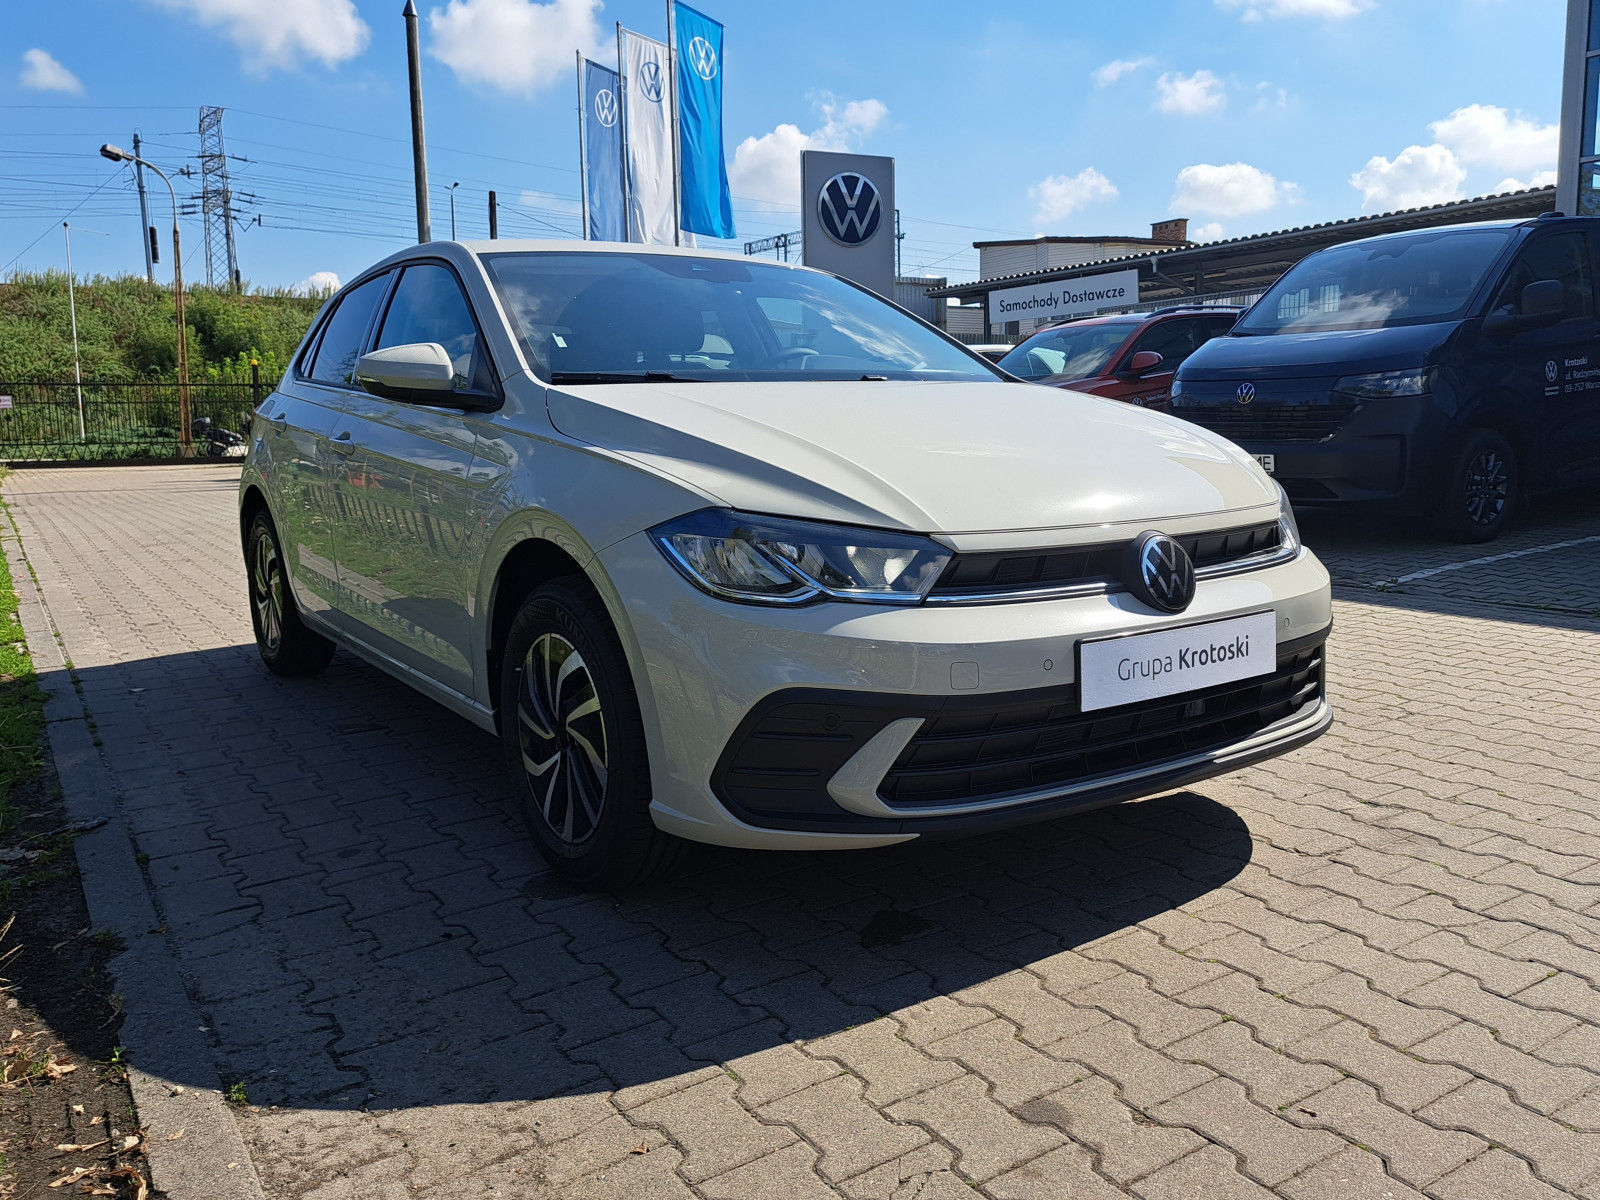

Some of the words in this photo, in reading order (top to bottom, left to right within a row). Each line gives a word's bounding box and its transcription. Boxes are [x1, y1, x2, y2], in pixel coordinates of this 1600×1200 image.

[999, 292, 1059, 313] Samochody
[1062, 287, 1126, 304] Dostawcze
[1564, 356, 1588, 367] Krotoski
[1117, 654, 1173, 681] Grupa
[1178, 634, 1249, 670] Krotoski
